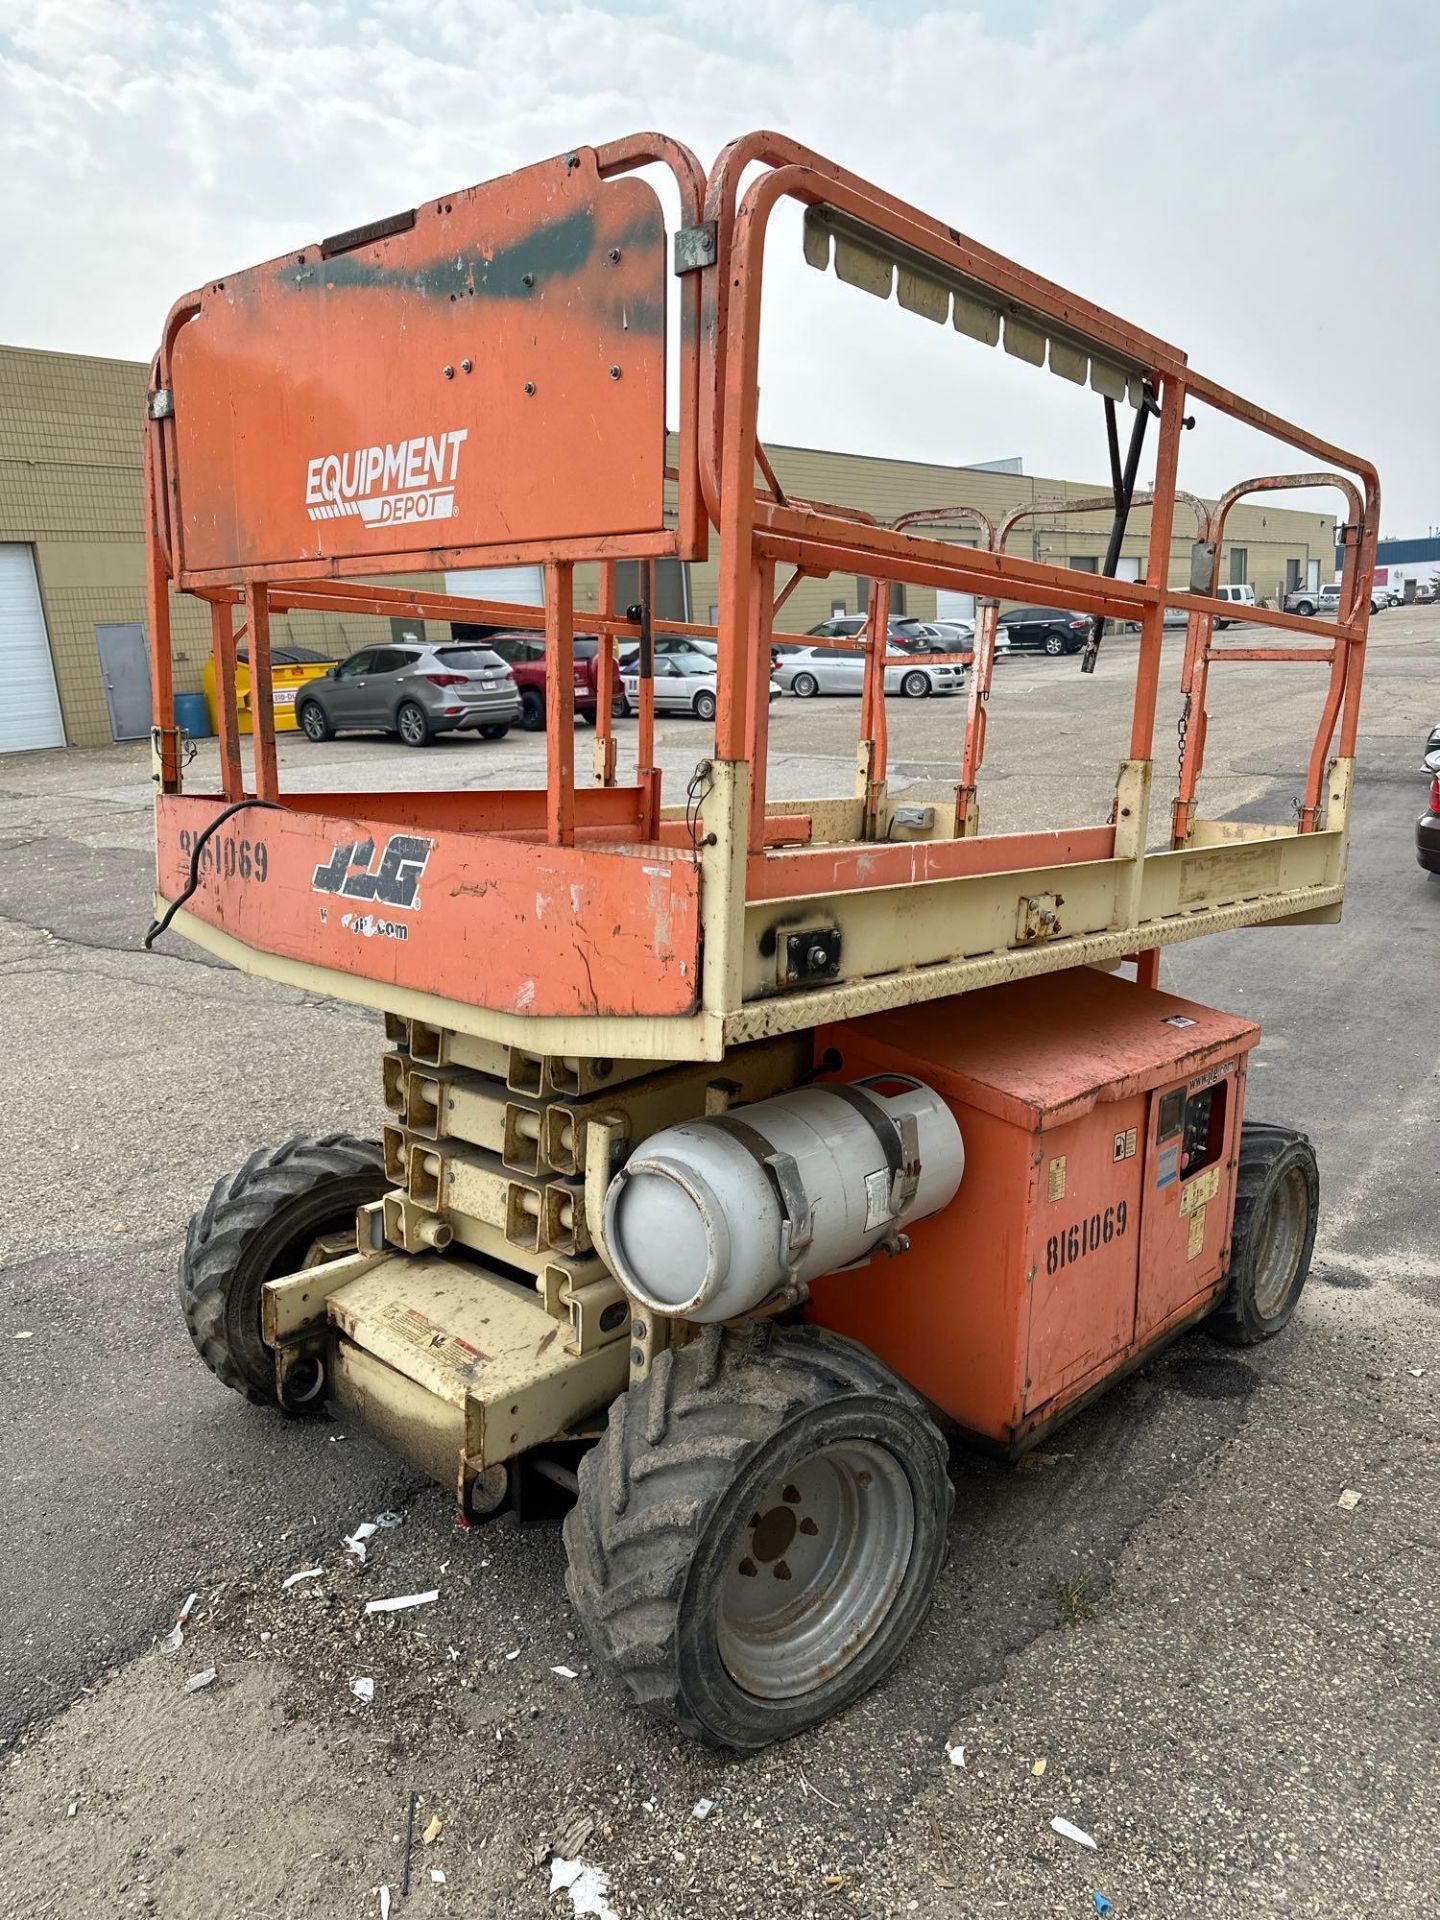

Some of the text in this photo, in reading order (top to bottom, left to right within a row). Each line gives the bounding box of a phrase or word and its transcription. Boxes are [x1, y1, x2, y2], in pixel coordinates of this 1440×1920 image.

[305, 428, 469, 506] EQUIPMENT
[380, 493, 442, 522] DEPOT
[311, 834, 435, 910] JLG
[1046, 1200, 1128, 1275] 8161069
